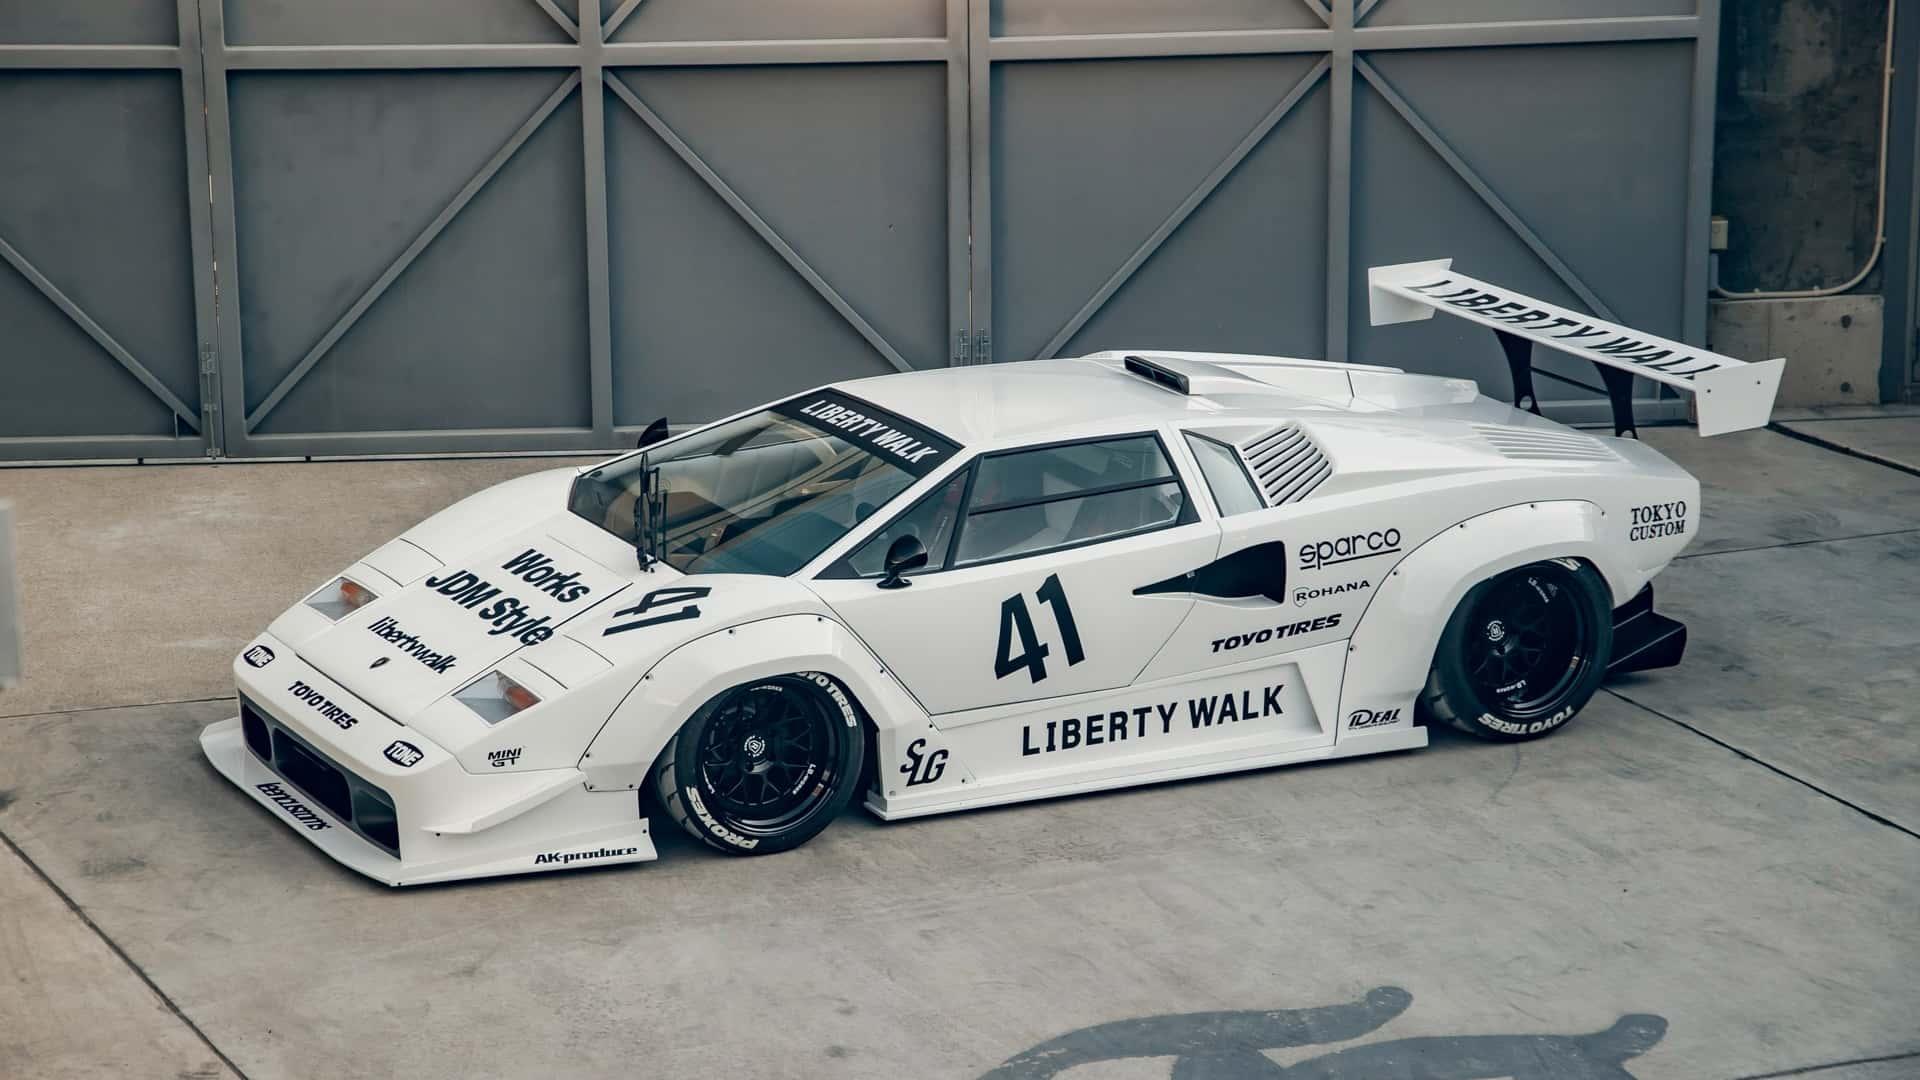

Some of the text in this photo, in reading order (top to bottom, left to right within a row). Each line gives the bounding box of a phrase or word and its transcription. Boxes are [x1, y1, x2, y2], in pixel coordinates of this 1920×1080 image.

[1404, 279, 1609, 338] LIBERTY
[800, 400, 939, 464] LIBERTY WALK
[1630, 520, 1686, 541] CUSTOM
[1631, 501, 1687, 525] TOKYO
[1299, 528, 1401, 570] sparco
[502, 548, 591, 603] Works
[1296, 580, 1371, 601] ROHANA
[426, 570, 555, 647] JDM Style
[602, 586, 712, 636] 41
[994, 573, 1086, 684] 41
[367, 616, 458, 675] libertywalk
[1211, 613, 1342, 653] TOYO TIRES
[245, 646, 274, 668] TONE
[287, 680, 359, 730] TOYO TIRES
[826, 680, 857, 728] TIRES
[1022, 684, 1284, 757] LIBERTY WALK
[1477, 705, 1575, 735] TOYO TIRES
[384, 740, 424, 767] TONE
[488, 748, 522, 760] MINI
[491, 756, 518, 768] GT
[685, 786, 760, 849] PROXES
[534, 847, 638, 865] AK-produce
